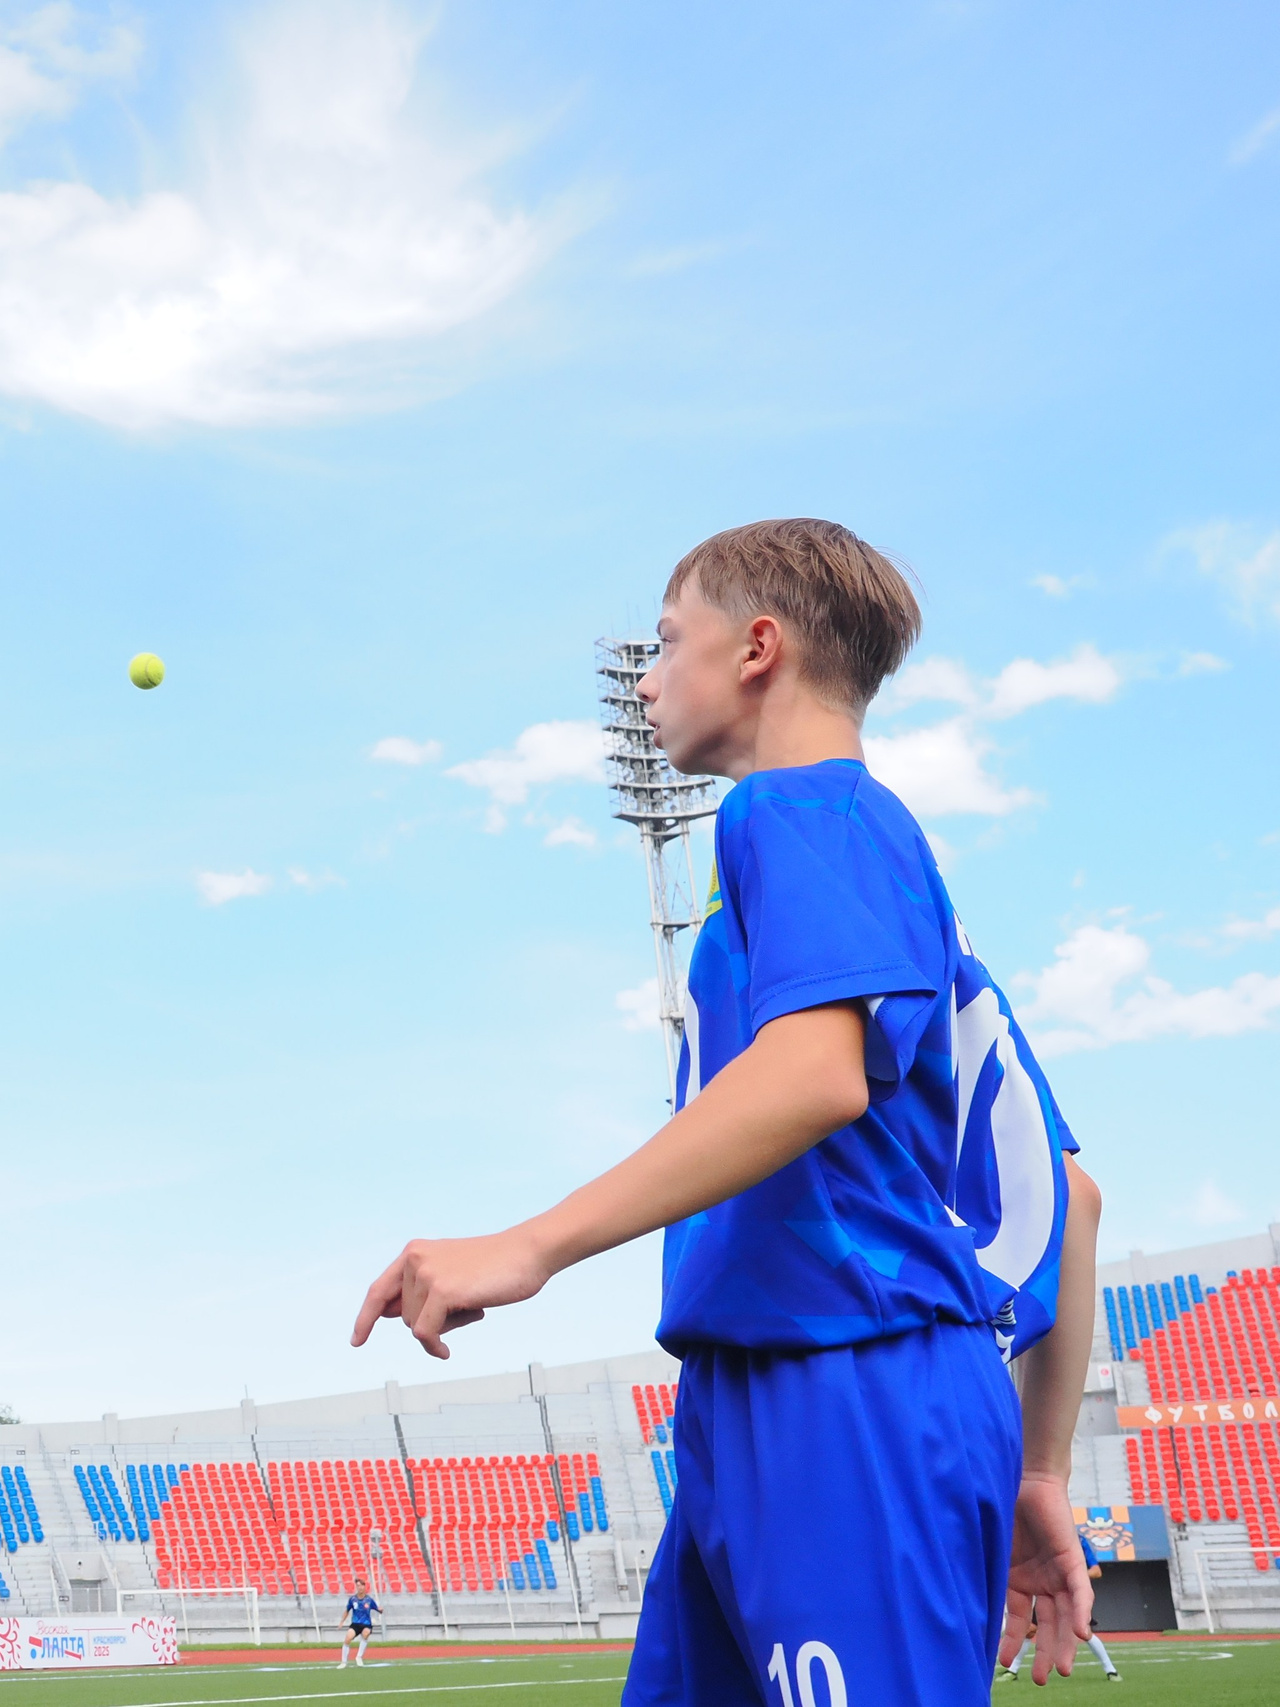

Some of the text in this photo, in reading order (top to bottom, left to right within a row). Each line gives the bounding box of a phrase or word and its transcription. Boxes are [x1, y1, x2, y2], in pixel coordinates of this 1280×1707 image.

[1144, 1401, 1279, 1424] ФУТБОЛ
[41, 1636, 85, 1659] ЛАПТА
[93, 1646, 110, 1656] 2025
[767, 1640, 848, 1707] 10
